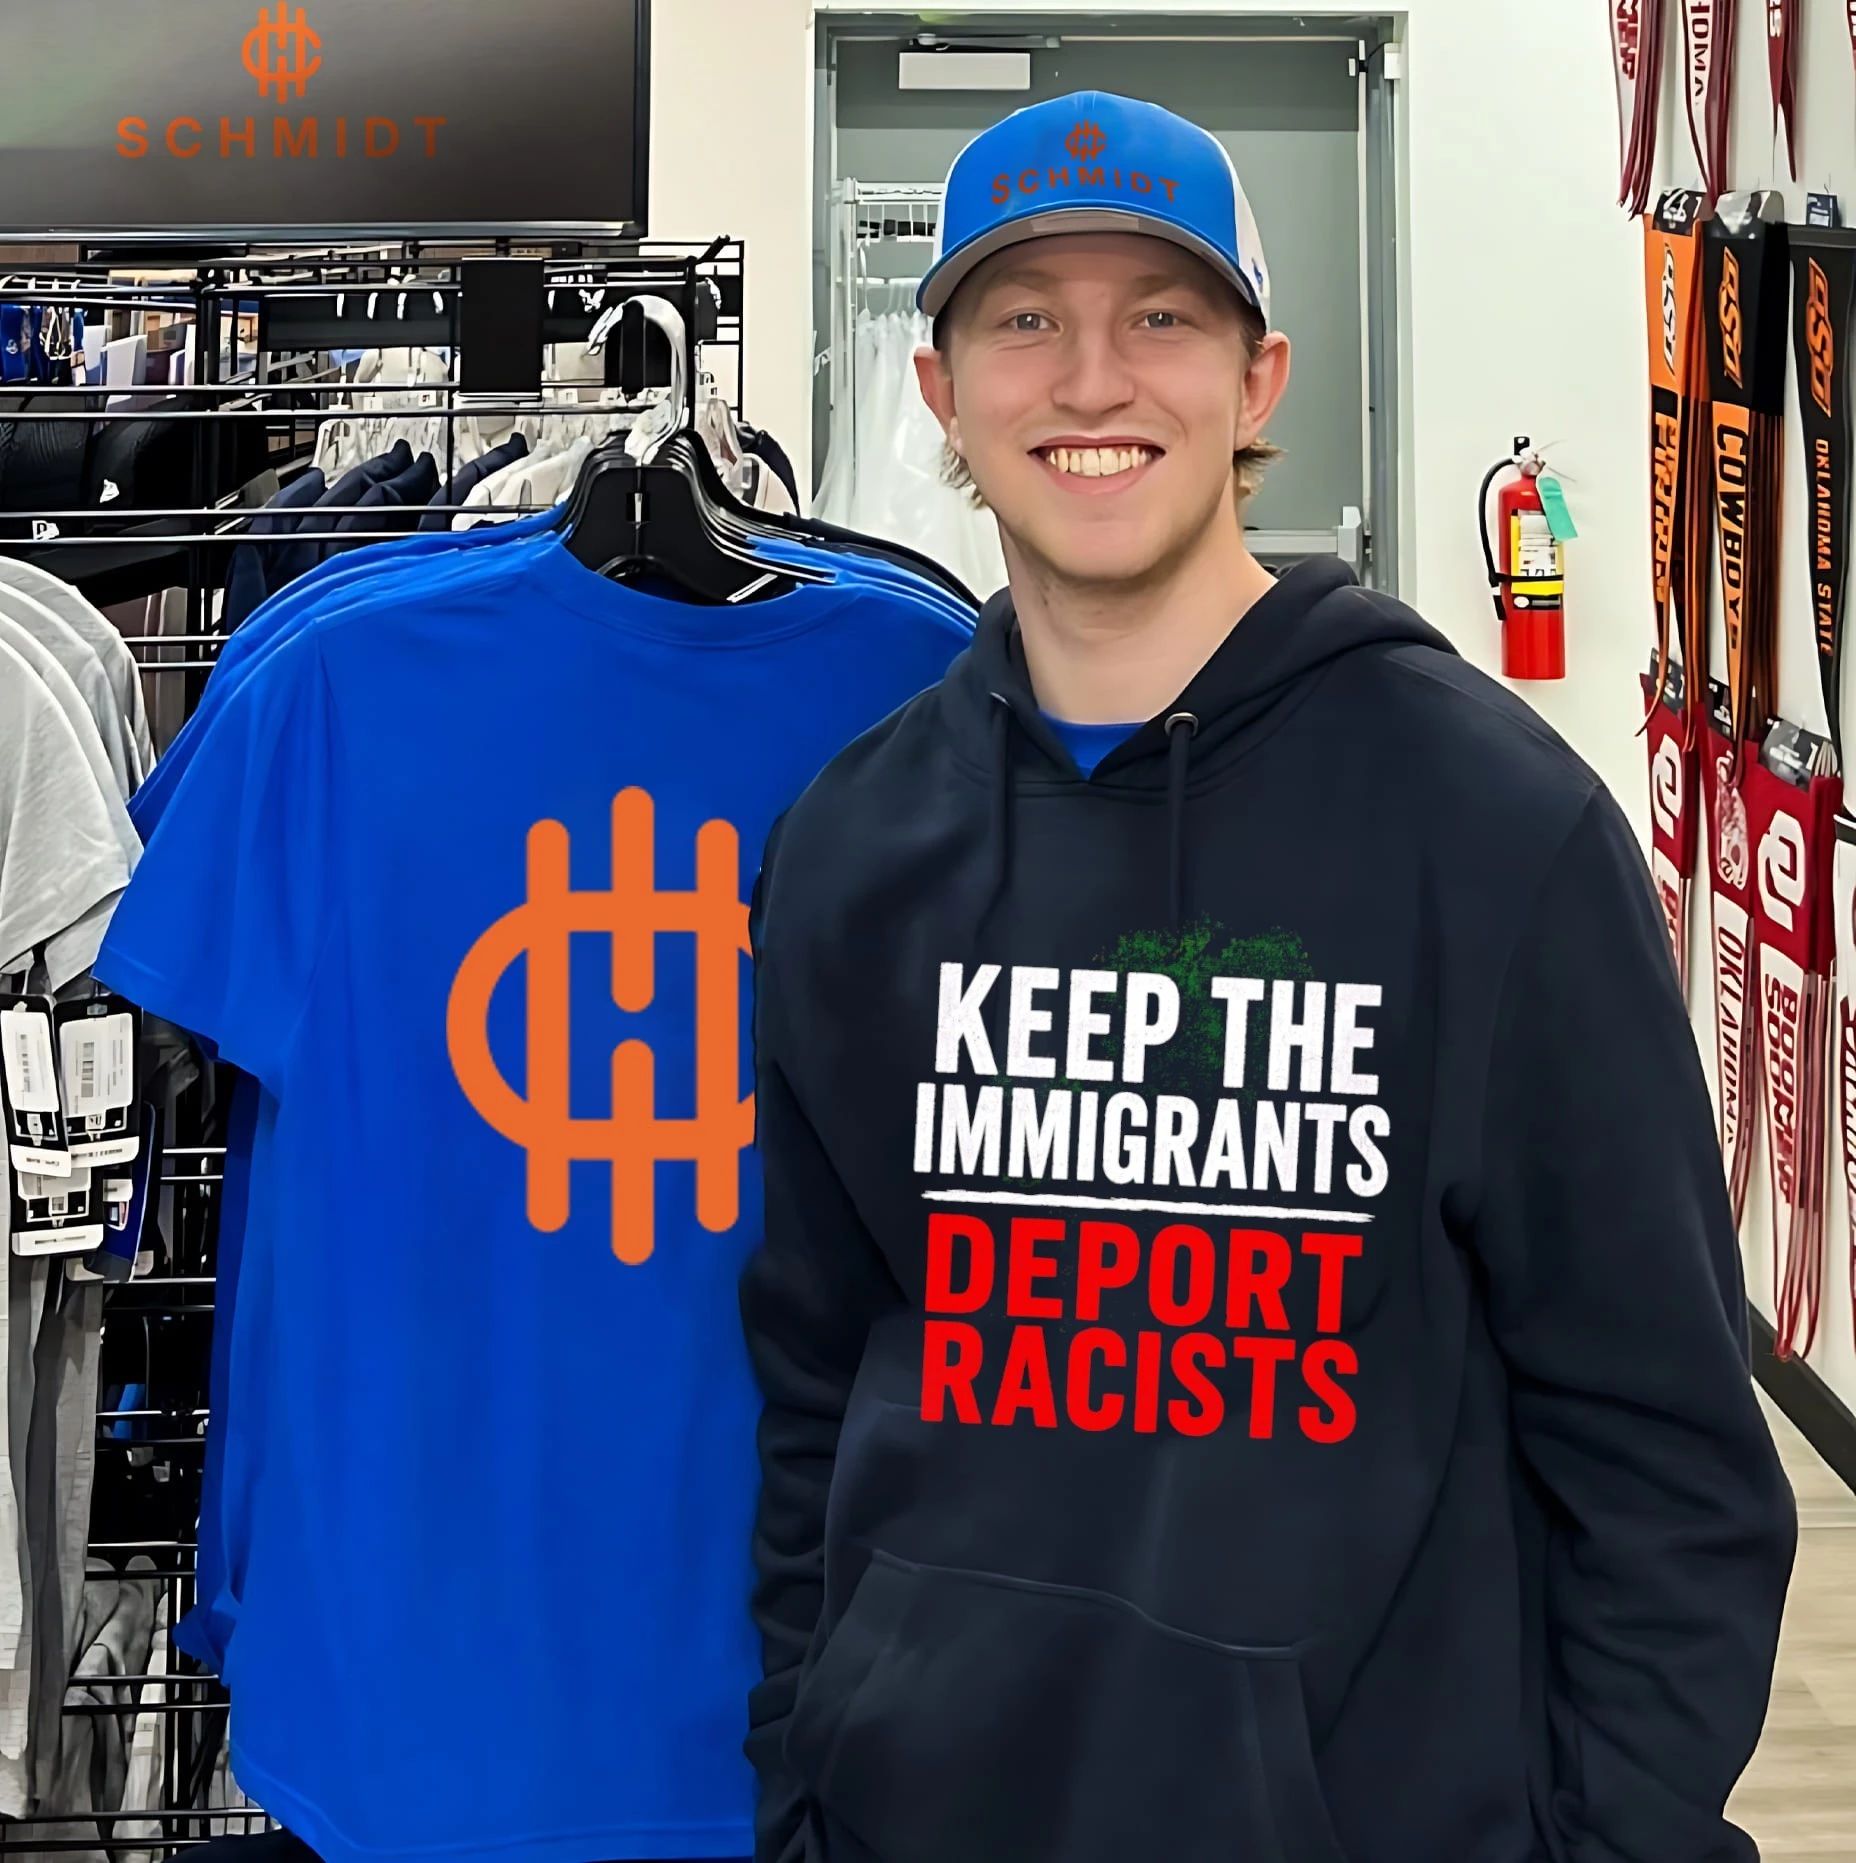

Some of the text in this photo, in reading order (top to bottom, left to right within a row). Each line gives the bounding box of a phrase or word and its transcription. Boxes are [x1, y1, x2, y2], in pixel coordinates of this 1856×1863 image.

[116, 117, 448, 159] SCHMIDT
[992, 166, 1180, 205] SCHMIDT
[1815, 438, 1834, 657] OKLAHOMA STATE
[935, 962, 1382, 1095] KEEP THE
[1718, 926, 1745, 1144] OKLAHOMA
[913, 1082, 1391, 1198] IMMIGRANTS
[925, 1213, 1363, 1334] DEPORT
[920, 1320, 1359, 1444] RACISTS
